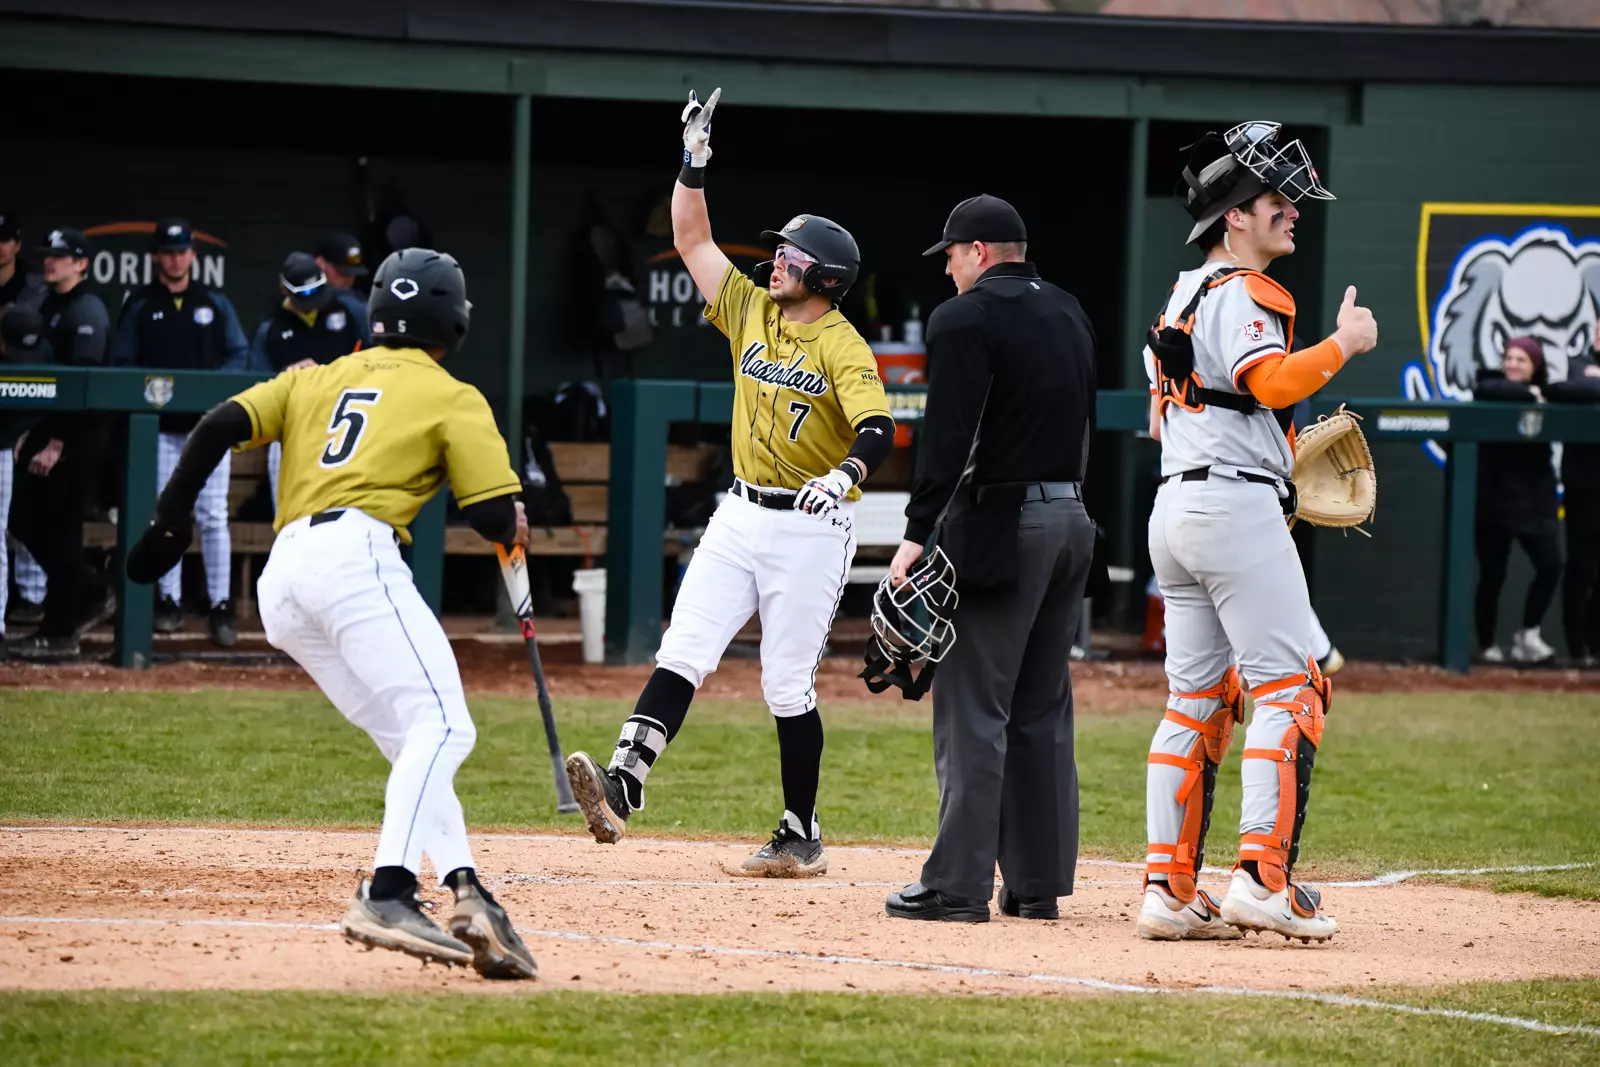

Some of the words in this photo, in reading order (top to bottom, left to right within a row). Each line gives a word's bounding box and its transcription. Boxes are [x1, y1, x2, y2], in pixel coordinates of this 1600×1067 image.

[398, 319, 406, 333] 5
[740, 341, 829, 396] Mastodons
[0, 382, 57, 398] TODONS
[320, 388, 383, 469] 5
[788, 400, 812, 442] 7
